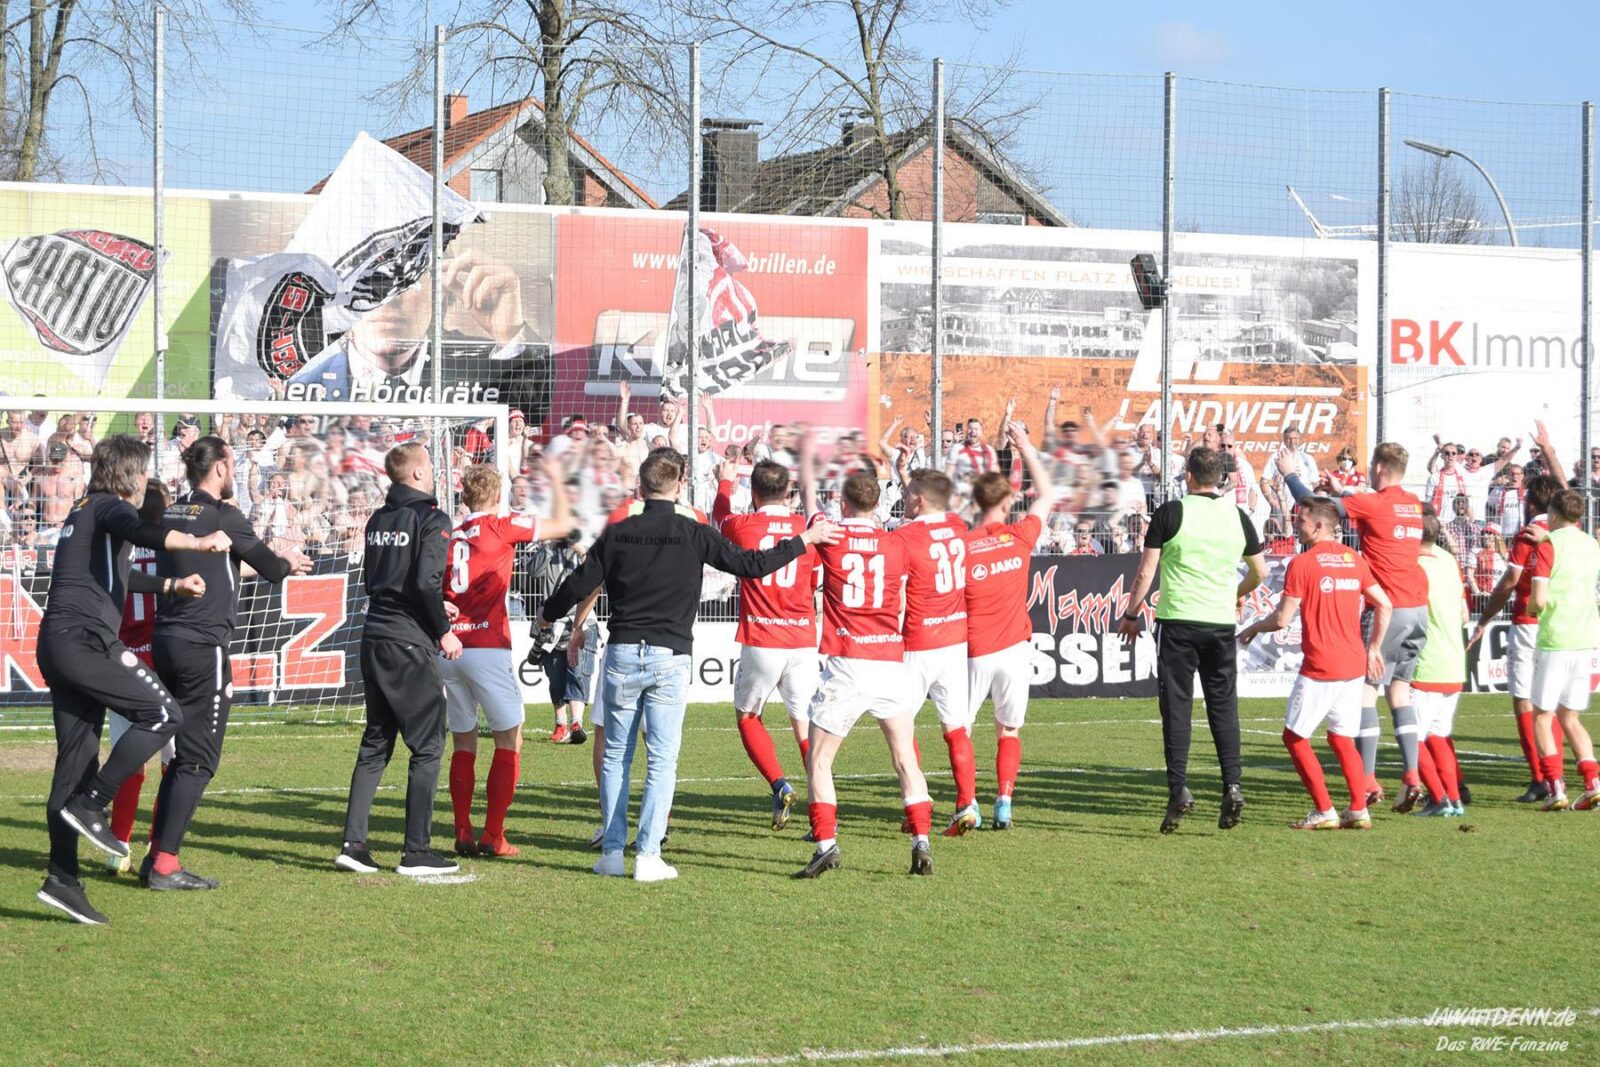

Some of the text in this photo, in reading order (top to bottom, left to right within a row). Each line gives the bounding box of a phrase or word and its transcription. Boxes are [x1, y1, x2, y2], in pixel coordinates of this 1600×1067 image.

[898, 265, 932, 275] WIR
[944, 266, 1046, 282] SCHAFFEN
[1056, 271, 1115, 284] PLATZ
[1117, 398, 1338, 435] LANDWEHR
[450, 541, 470, 594] 8
[841, 553, 885, 609] 31
[929, 538, 966, 594] 32
[990, 556, 1022, 575] JAKO
